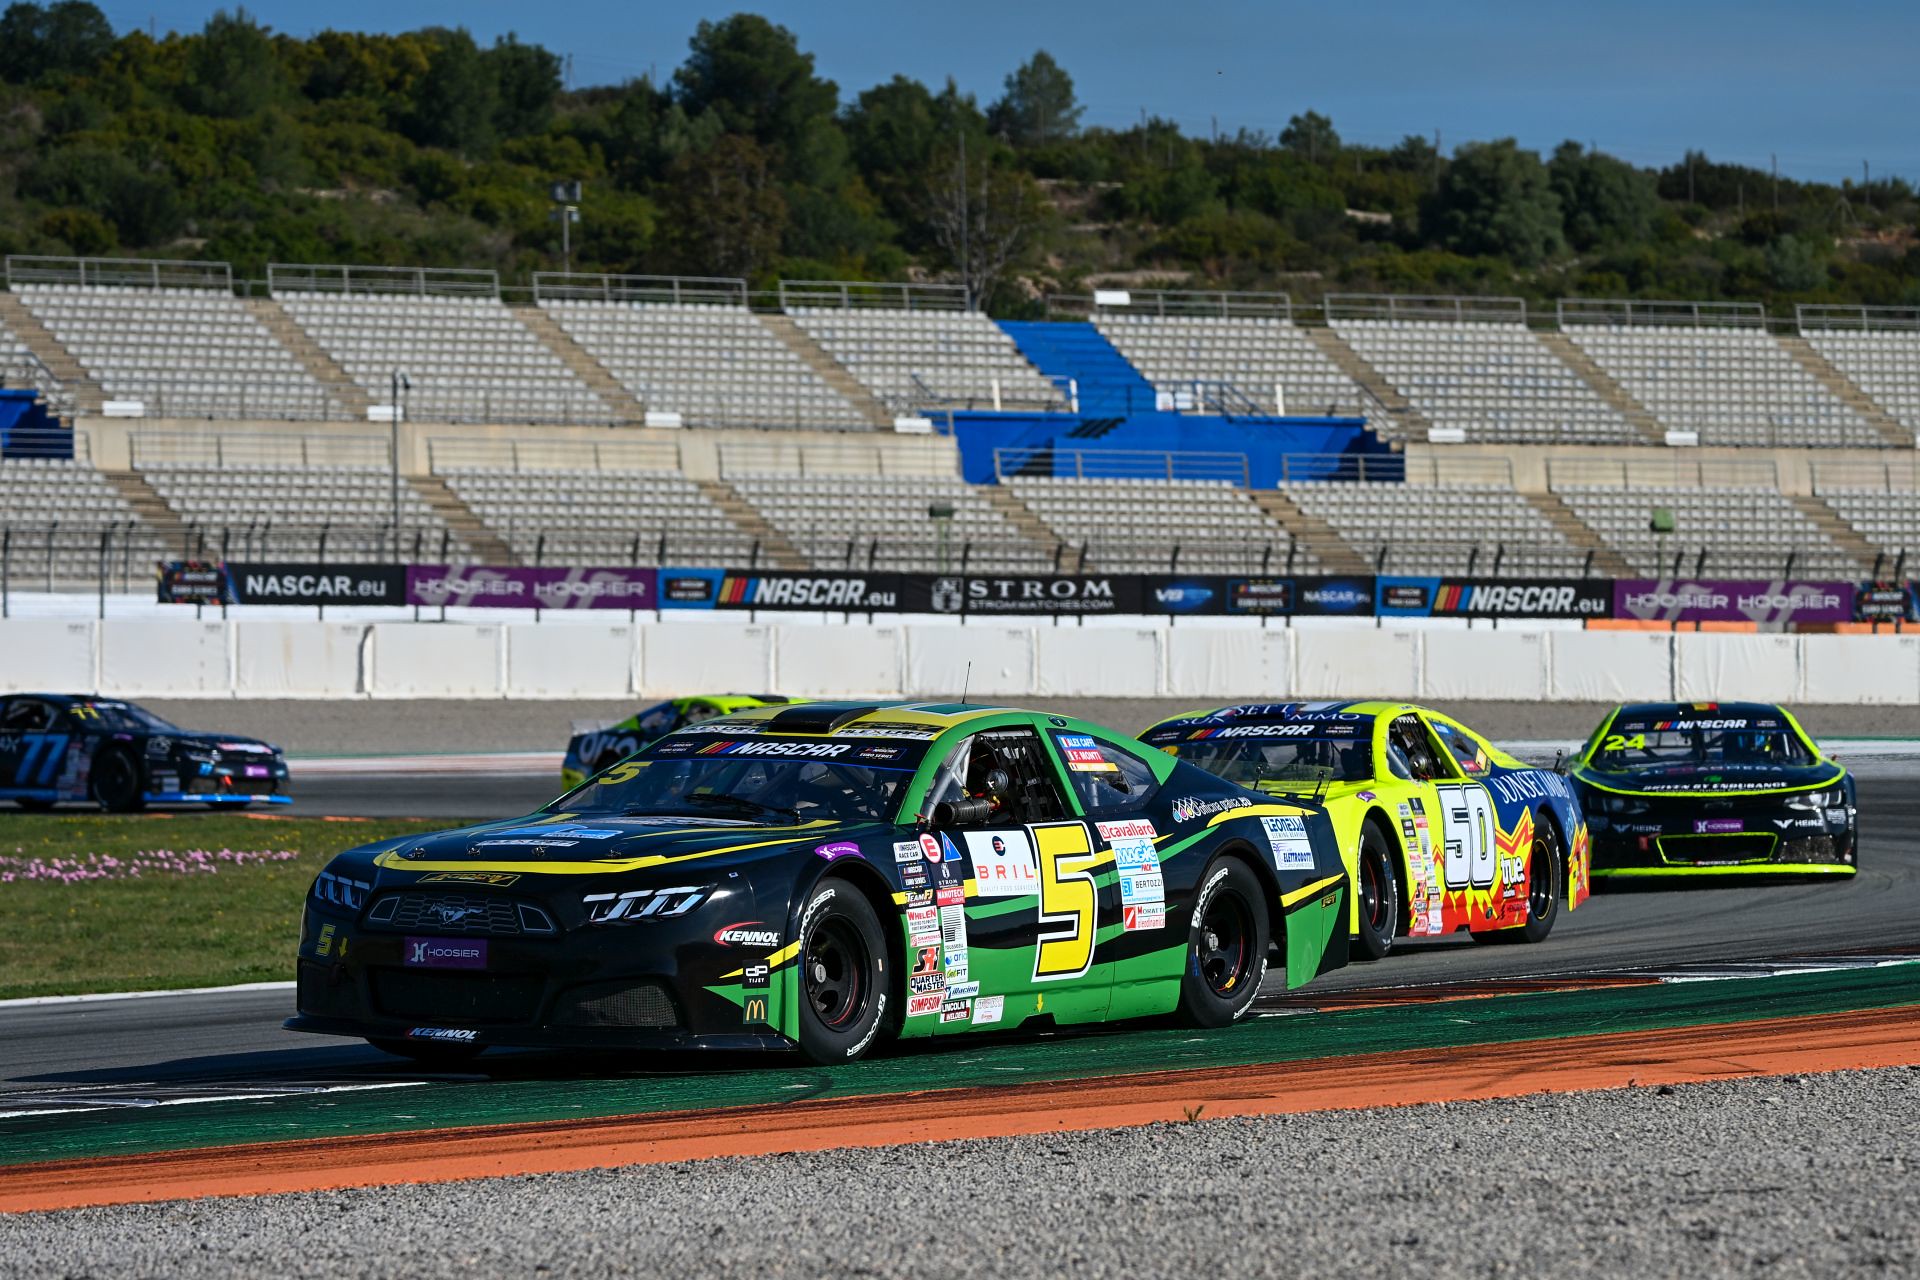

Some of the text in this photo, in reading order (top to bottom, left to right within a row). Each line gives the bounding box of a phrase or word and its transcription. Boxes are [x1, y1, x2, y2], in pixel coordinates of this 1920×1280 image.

[247, 574, 386, 597] NASCAR.eu
[414, 578, 646, 598] HOOSIER HOOSIER
[754, 578, 896, 607] NASCAR.eu
[968, 579, 1113, 598] STROM
[1468, 585, 1605, 614] NASCAR.eu
[1625, 592, 1840, 610] HOOSIER HOOSIER
[1216, 724, 1315, 738] NASCAR
[728, 742, 852, 758] NASCAR
[1604, 734, 1645, 751] 24
[16, 735, 69, 784] 77
[599, 761, 653, 785] 5
[1110, 822, 1155, 838] cavallaro
[1631, 824, 1662, 832] HEINZ
[1794, 819, 1824, 827] HEINZ
[1436, 782, 1497, 891] 50
[922, 838, 938, 857] E
[1500, 852, 1526, 885] true
[1135, 879, 1163, 889] BERTOZZI
[937, 888, 964, 898] NANOTECH
[1031, 820, 1098, 983] 5
[907, 907, 937, 920] WHELEN
[315, 923, 337, 957] 5
[719, 930, 779, 943] KENNOL
[427, 948, 480, 959] HOOSIER
[910, 973, 943, 989] QUARTER
[916, 980, 944, 994] MASTER
[910, 995, 942, 1014] SIMPSON
[942, 1000, 966, 1013] LINCOLN
[409, 1027, 477, 1040] KENNOL
